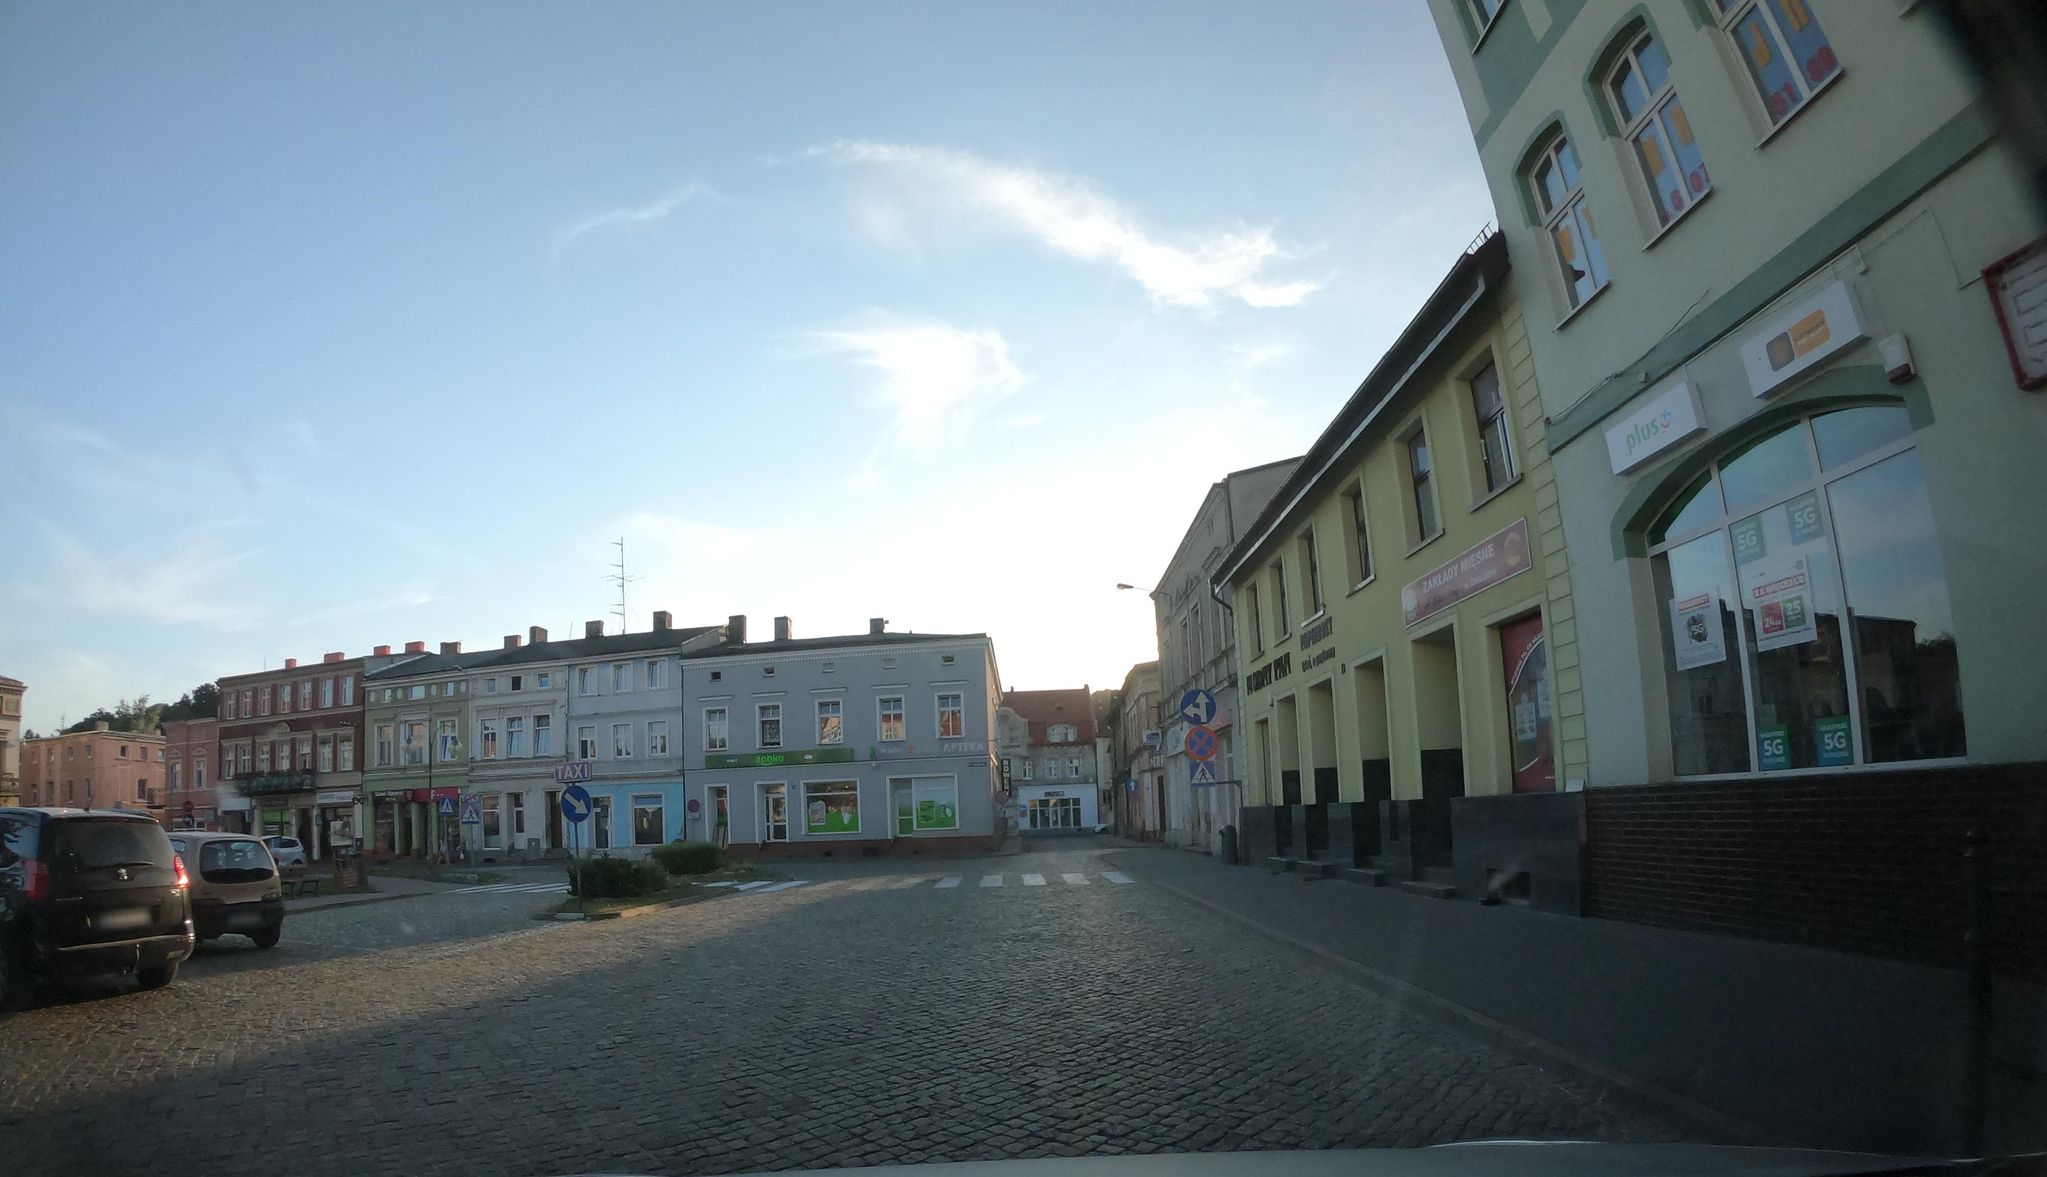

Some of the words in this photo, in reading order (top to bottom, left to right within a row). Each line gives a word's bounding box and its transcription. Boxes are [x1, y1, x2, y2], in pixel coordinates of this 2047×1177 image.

[1794, 506, 1816, 528] 5G
[1737, 530, 1757, 551] 5G
[1421, 563, 1459, 594] ZAKŁADY
[1460, 543, 1496, 574] MIĘSNE
[1763, 739, 1784, 756] 5G
[1824, 731, 1847, 750] 5G
[556, 763, 588, 780] TAXI
